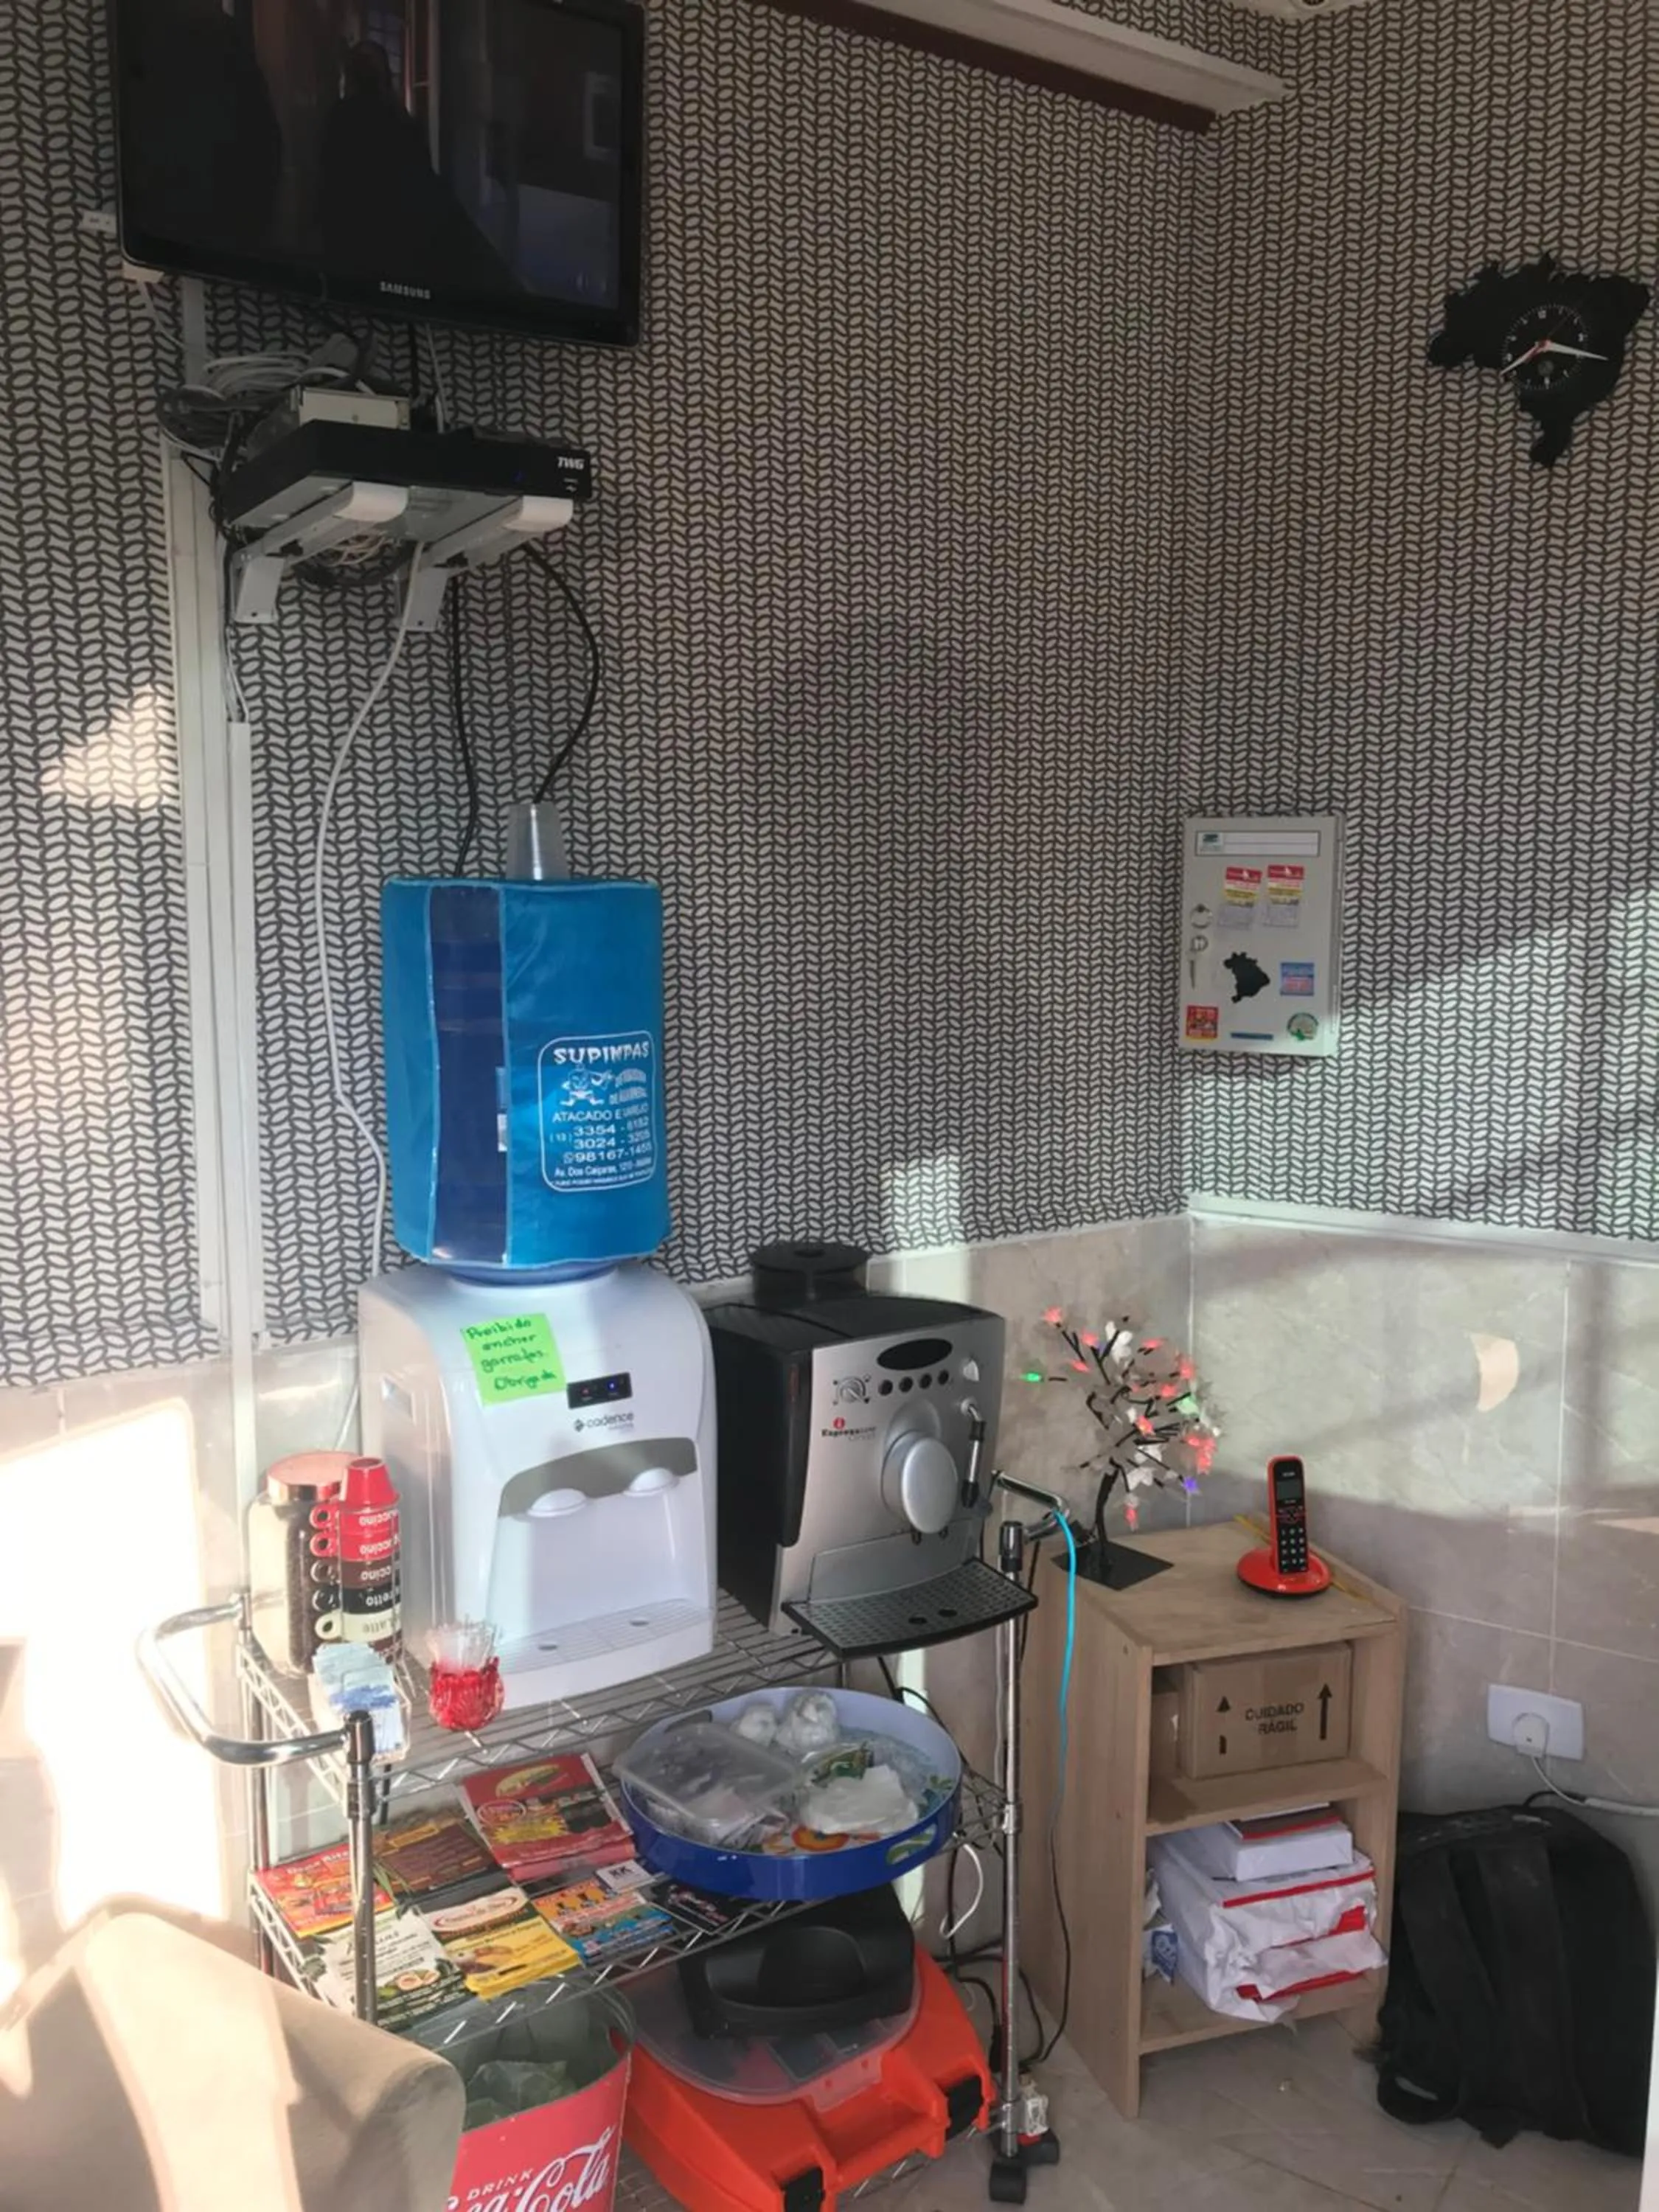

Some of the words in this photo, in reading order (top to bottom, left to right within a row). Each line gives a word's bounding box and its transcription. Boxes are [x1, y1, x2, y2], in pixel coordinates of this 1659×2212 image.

[380, 281, 431, 299] SAMSUNG
[552, 1109, 613, 1123] ATACADO
[573, 1124, 616, 1136] 3354
[573, 1136, 616, 1150] 3024
[587, 1412, 634, 1428] cadence
[1245, 1702, 1304, 1721] CUIDADO
[466, 2168, 533, 2201] DRINK
